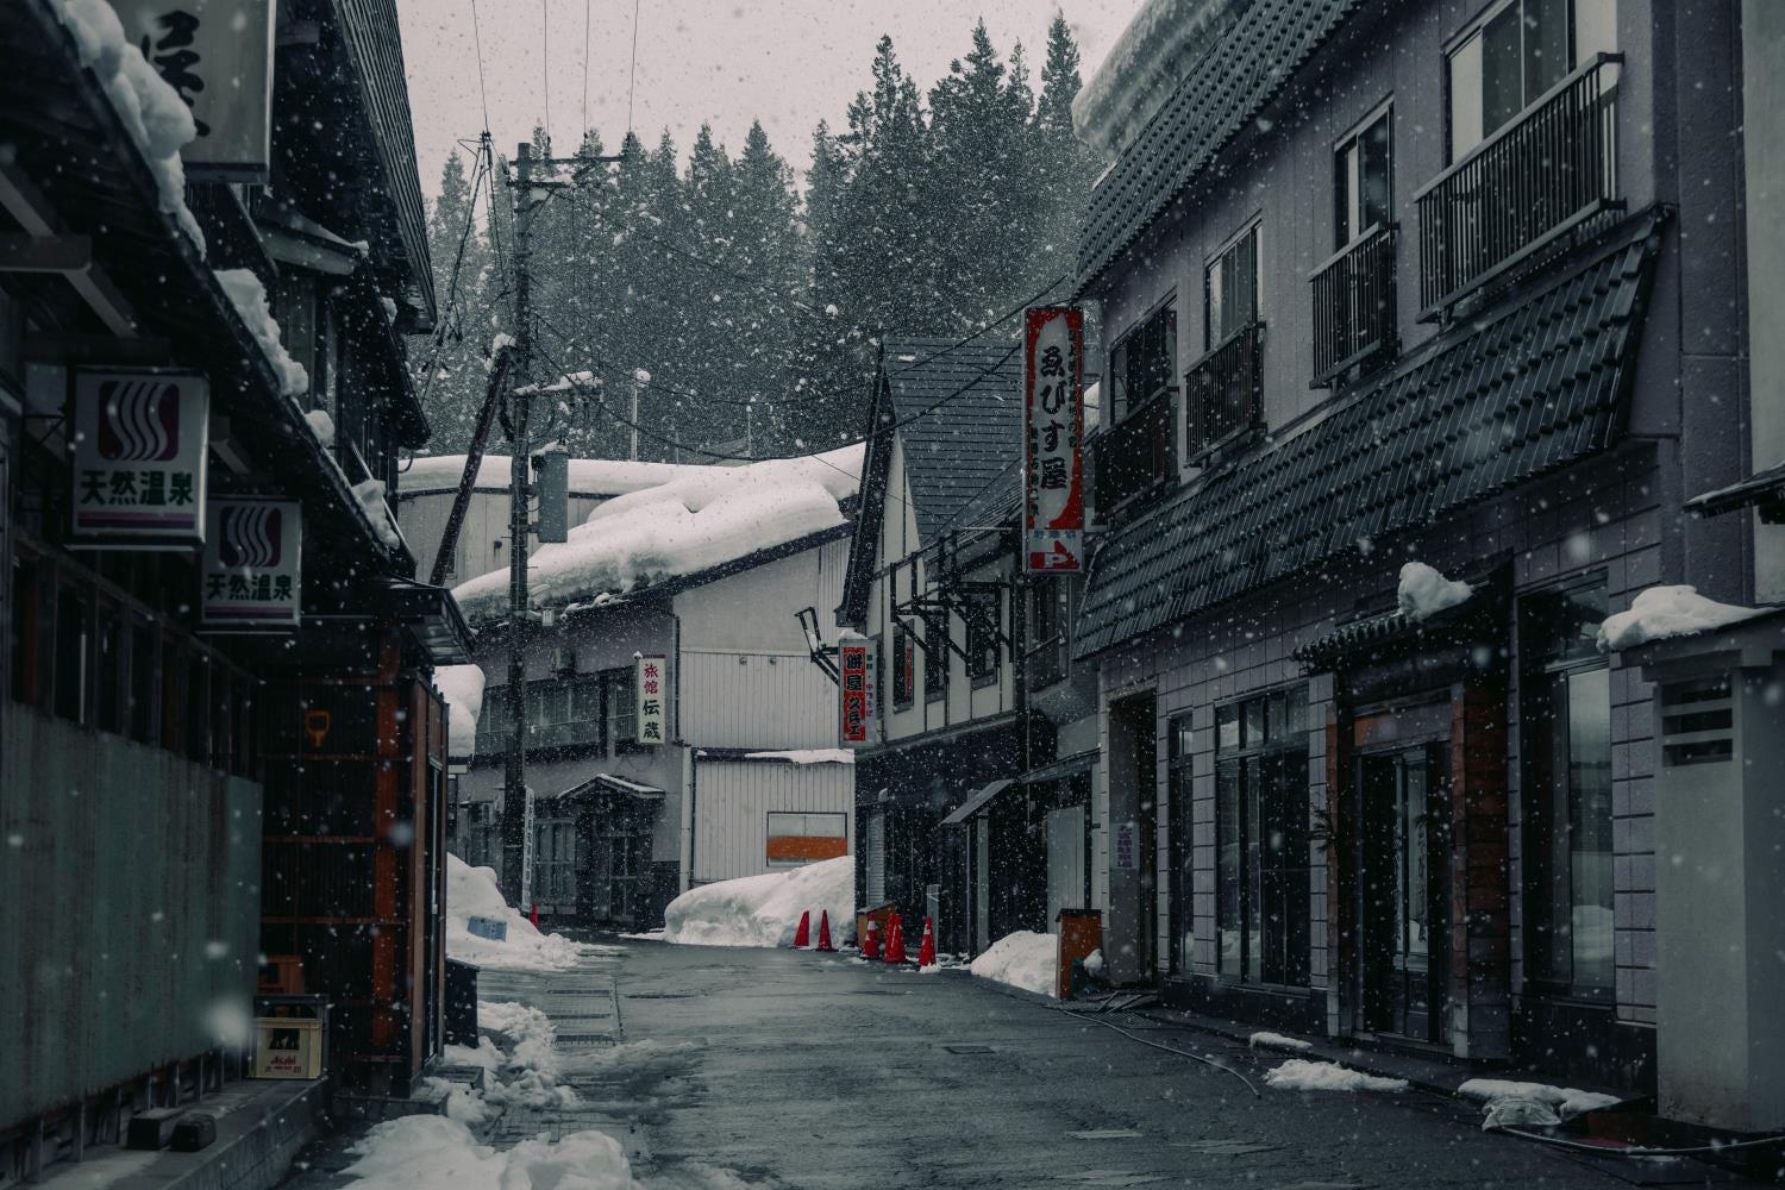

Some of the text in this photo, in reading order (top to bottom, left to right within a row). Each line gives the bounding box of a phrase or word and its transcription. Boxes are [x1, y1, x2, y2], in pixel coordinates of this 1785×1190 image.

[81, 470, 193, 506] 天然温泉
[207, 574, 292, 601] 天然温泉
